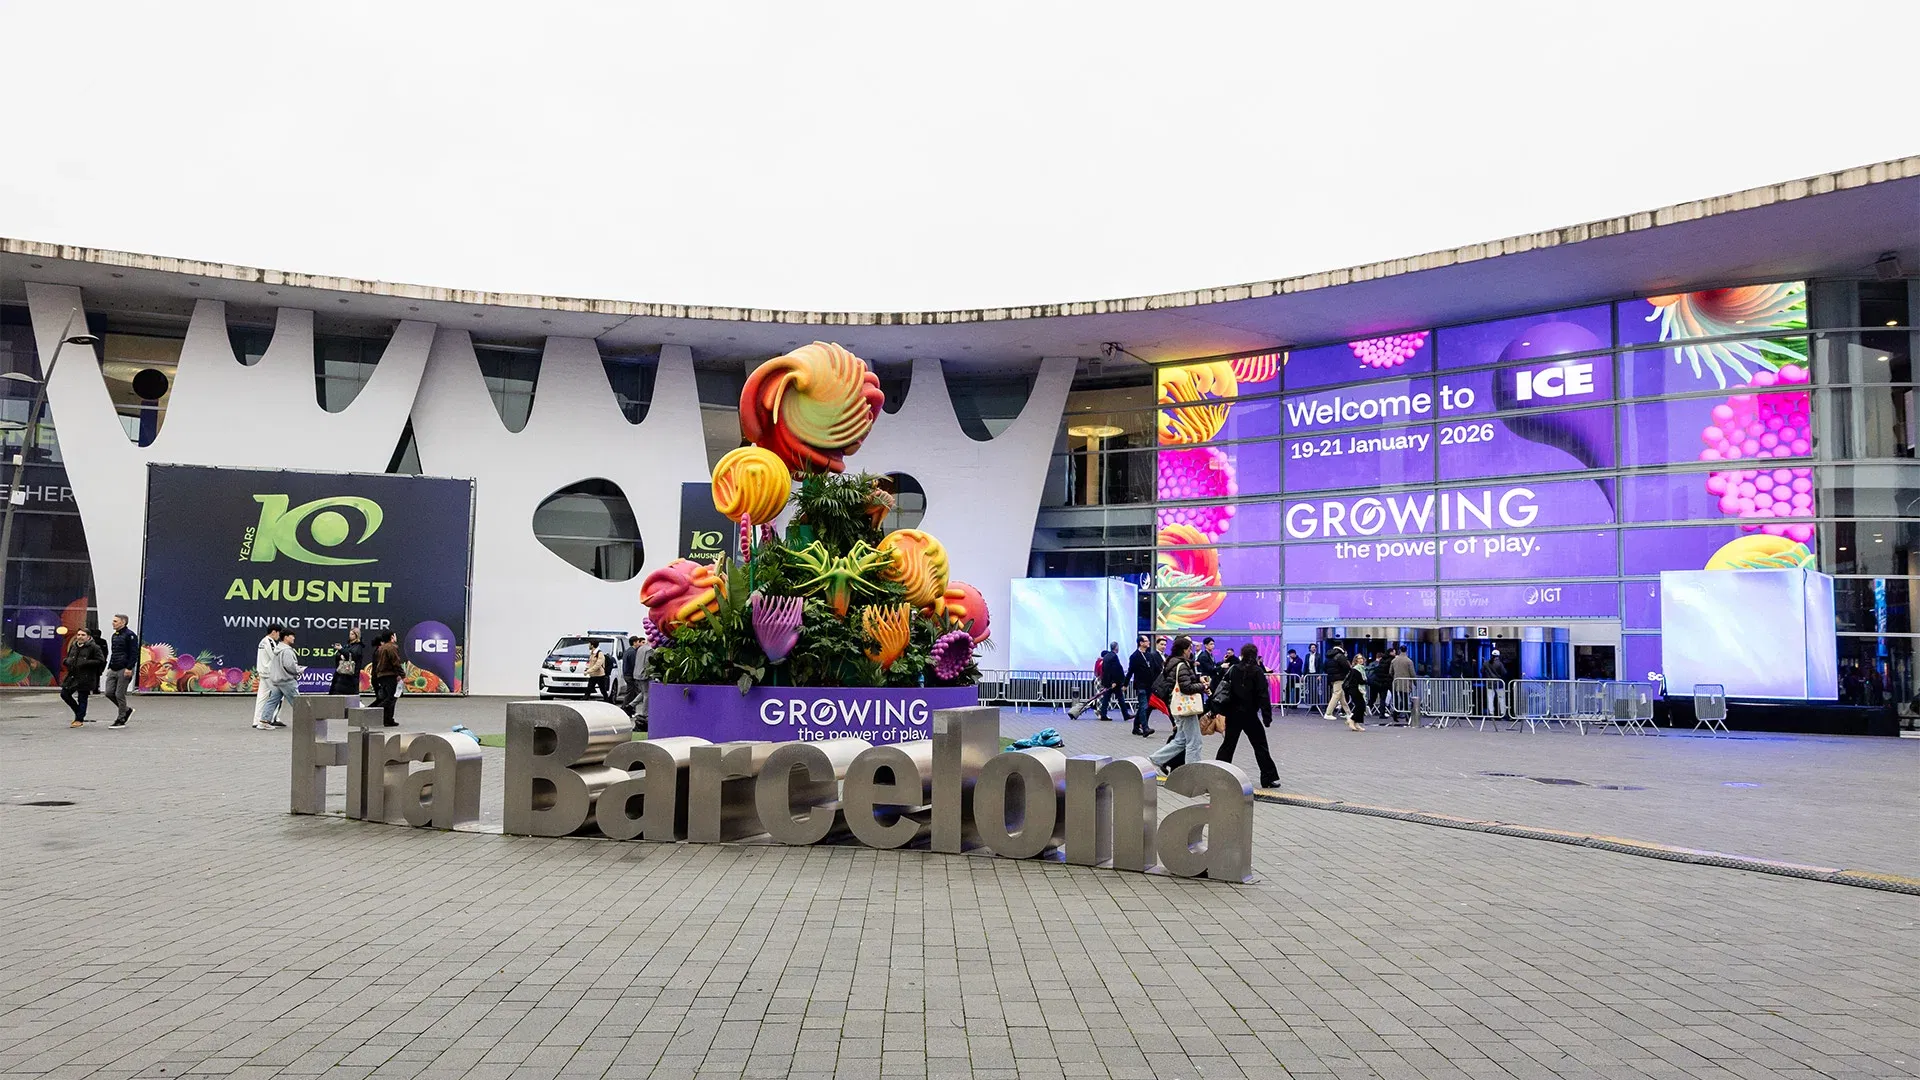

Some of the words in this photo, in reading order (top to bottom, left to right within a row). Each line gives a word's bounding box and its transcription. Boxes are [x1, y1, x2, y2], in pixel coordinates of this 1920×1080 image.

[1516, 363, 1594, 401] ICE
[1287, 391, 1432, 427] Welcome
[1439, 385, 1475, 410] to
[1291, 440, 1343, 459] 19-21
[1347, 433, 1431, 454] January
[1440, 424, 1495, 445] 2026
[1285, 488, 1539, 539] GROWING
[238, 526, 256, 562] YEARS
[1335, 541, 1371, 559] the
[1376, 538, 1448, 562] power
[1453, 536, 1478, 555] of
[1484, 534, 1542, 558] play.
[224, 578, 392, 604] AMUSNET
[1540, 588, 1562, 602] IGT
[16, 624, 56, 639] ICE
[223, 615, 300, 629] WINNING
[304, 617, 391, 630] TOGETHER
[414, 639, 449, 653] ICE
[759, 698, 929, 726] GROWING
[798, 728, 825, 741] the
[828, 731, 879, 742] power
[882, 728, 897, 741] of
[900, 728, 929, 744] play.
[290, 695, 481, 830] Fira
[503, 700, 1255, 882] Barcelona
